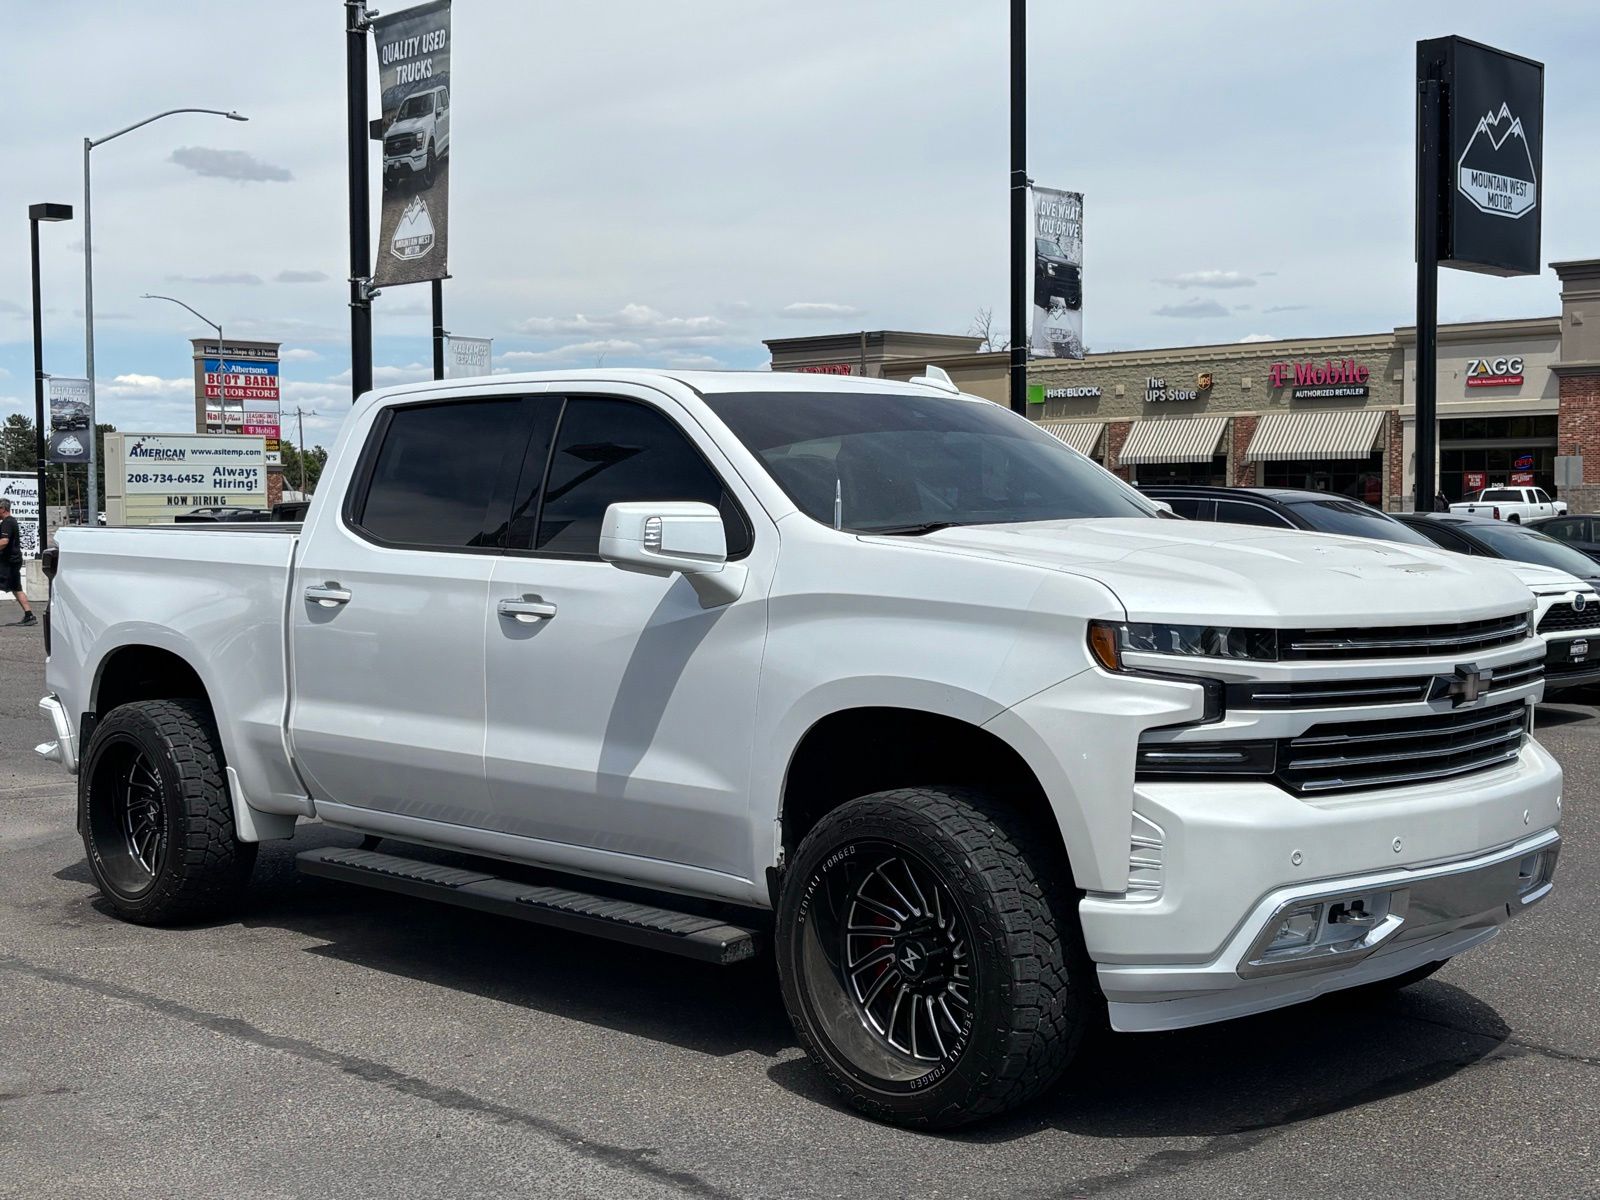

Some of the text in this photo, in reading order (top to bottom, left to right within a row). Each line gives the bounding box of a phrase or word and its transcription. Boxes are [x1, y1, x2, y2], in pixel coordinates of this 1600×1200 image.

[382, 28, 446, 65] QUALITY USED
[395, 58, 433, 86] TRUCKS
[1471, 170, 1528, 198] MOUNTAIN WEST
[1487, 191, 1513, 210] MOTOR
[1058, 203, 1080, 220] WHAT
[1039, 217, 1080, 238] YOU DRIVE
[230, 365, 268, 374] Albertsons
[1292, 358, 1370, 386] Mobile
[1467, 357, 1523, 376] ZAGG
[207, 374, 276, 387] BOOT BARN
[1145, 376, 1165, 388] The
[1198, 375, 1211, 388] ups
[246, 388, 277, 398] STORE
[1047, 387, 1099, 398] H&R BLOCK
[1144, 388, 1197, 402] UPS Store
[1295, 388, 1364, 398] AUTHORIZED RETAILER
[207, 412, 227, 421] Nais
[129, 446, 186, 458] AMERICAN
[190, 448, 262, 458] www.asitemp.com
[127, 473, 205, 483] 208-734-6452
[213, 466, 258, 479] Always
[213, 478, 258, 491] Hiring!
[4, 487, 38, 496] AMERICA
[167, 495, 227, 506] NOW HIRING
[822, 845, 856, 873] FORGED
[798, 874, 821, 924] SENTALI
[948, 1011, 974, 1062] SENTALI
[910, 1064, 946, 1089] FORGED
